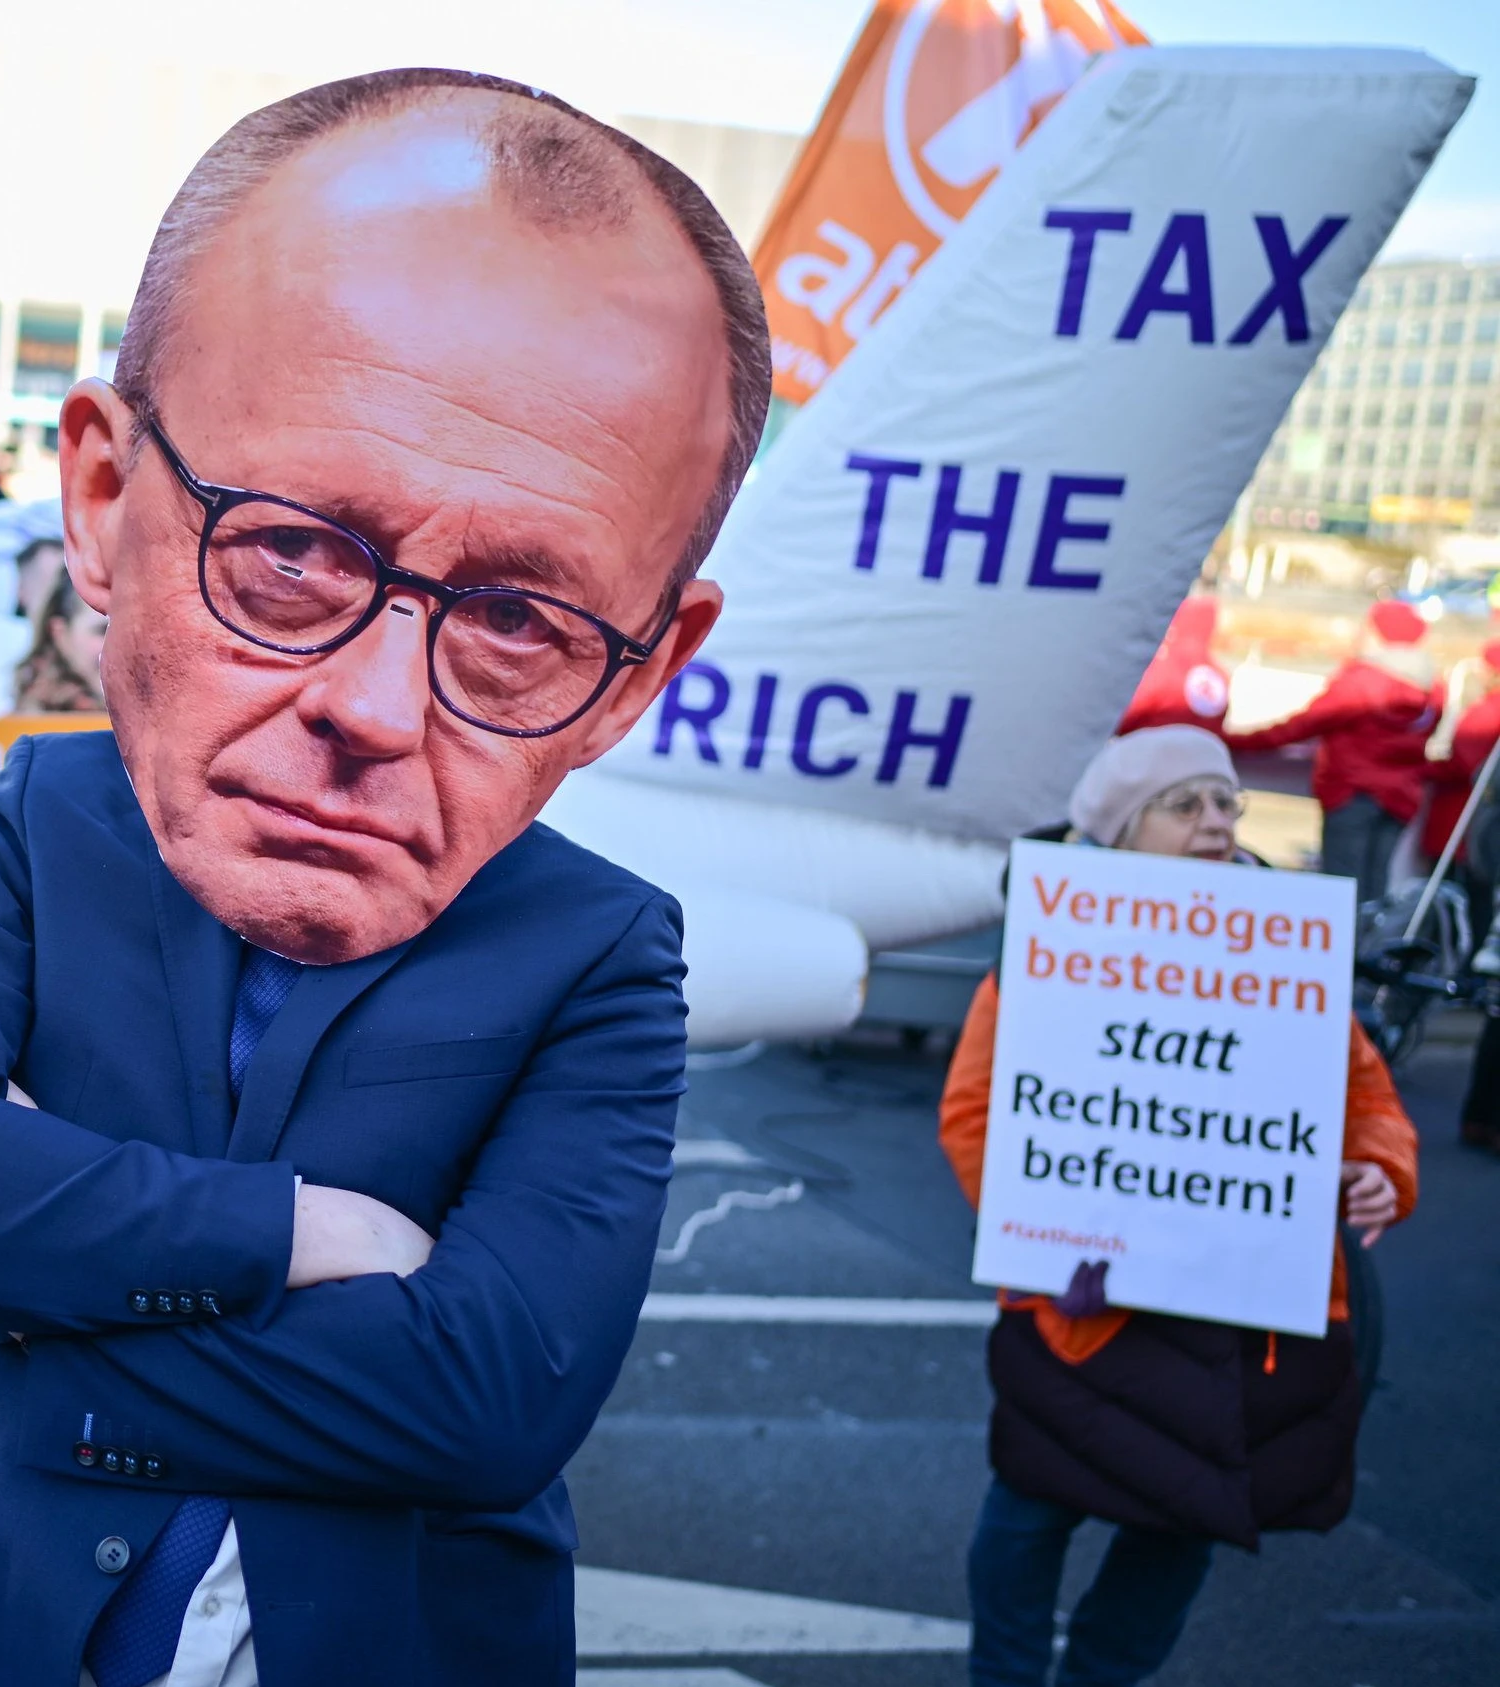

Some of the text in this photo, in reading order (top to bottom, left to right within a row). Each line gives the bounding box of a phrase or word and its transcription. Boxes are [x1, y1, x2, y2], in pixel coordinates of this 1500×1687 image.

[1042, 208, 1351, 350] TAX
[845, 452, 1128, 595] THE
[652, 658, 975, 792] RICH
[1032, 874, 1333, 954] Vermögen
[1026, 935, 1328, 1016] besteuern
[1098, 1018, 1242, 1076] statt
[1011, 1071, 1319, 1159] Rechtsruck
[1021, 1135, 1297, 1221] befeuern!
